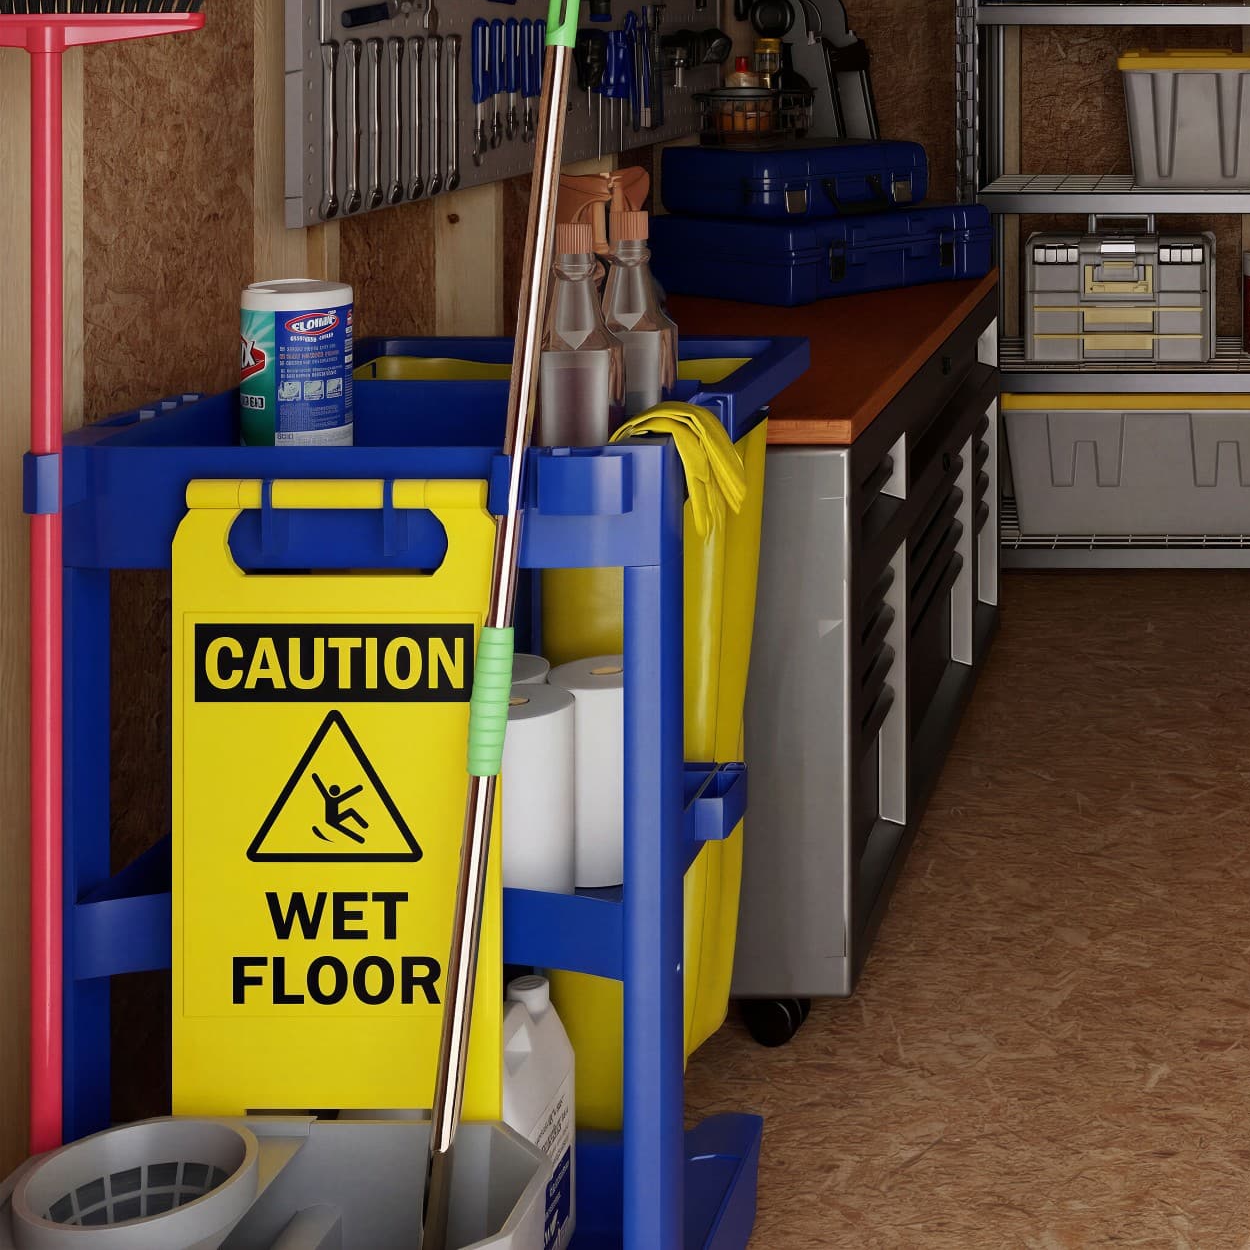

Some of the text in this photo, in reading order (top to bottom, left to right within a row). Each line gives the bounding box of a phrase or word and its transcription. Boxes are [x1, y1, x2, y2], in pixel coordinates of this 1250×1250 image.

[205, 637, 464, 689] CAUTION
[265, 892, 408, 939] WET
[232, 955, 441, 1005] FLOOR
